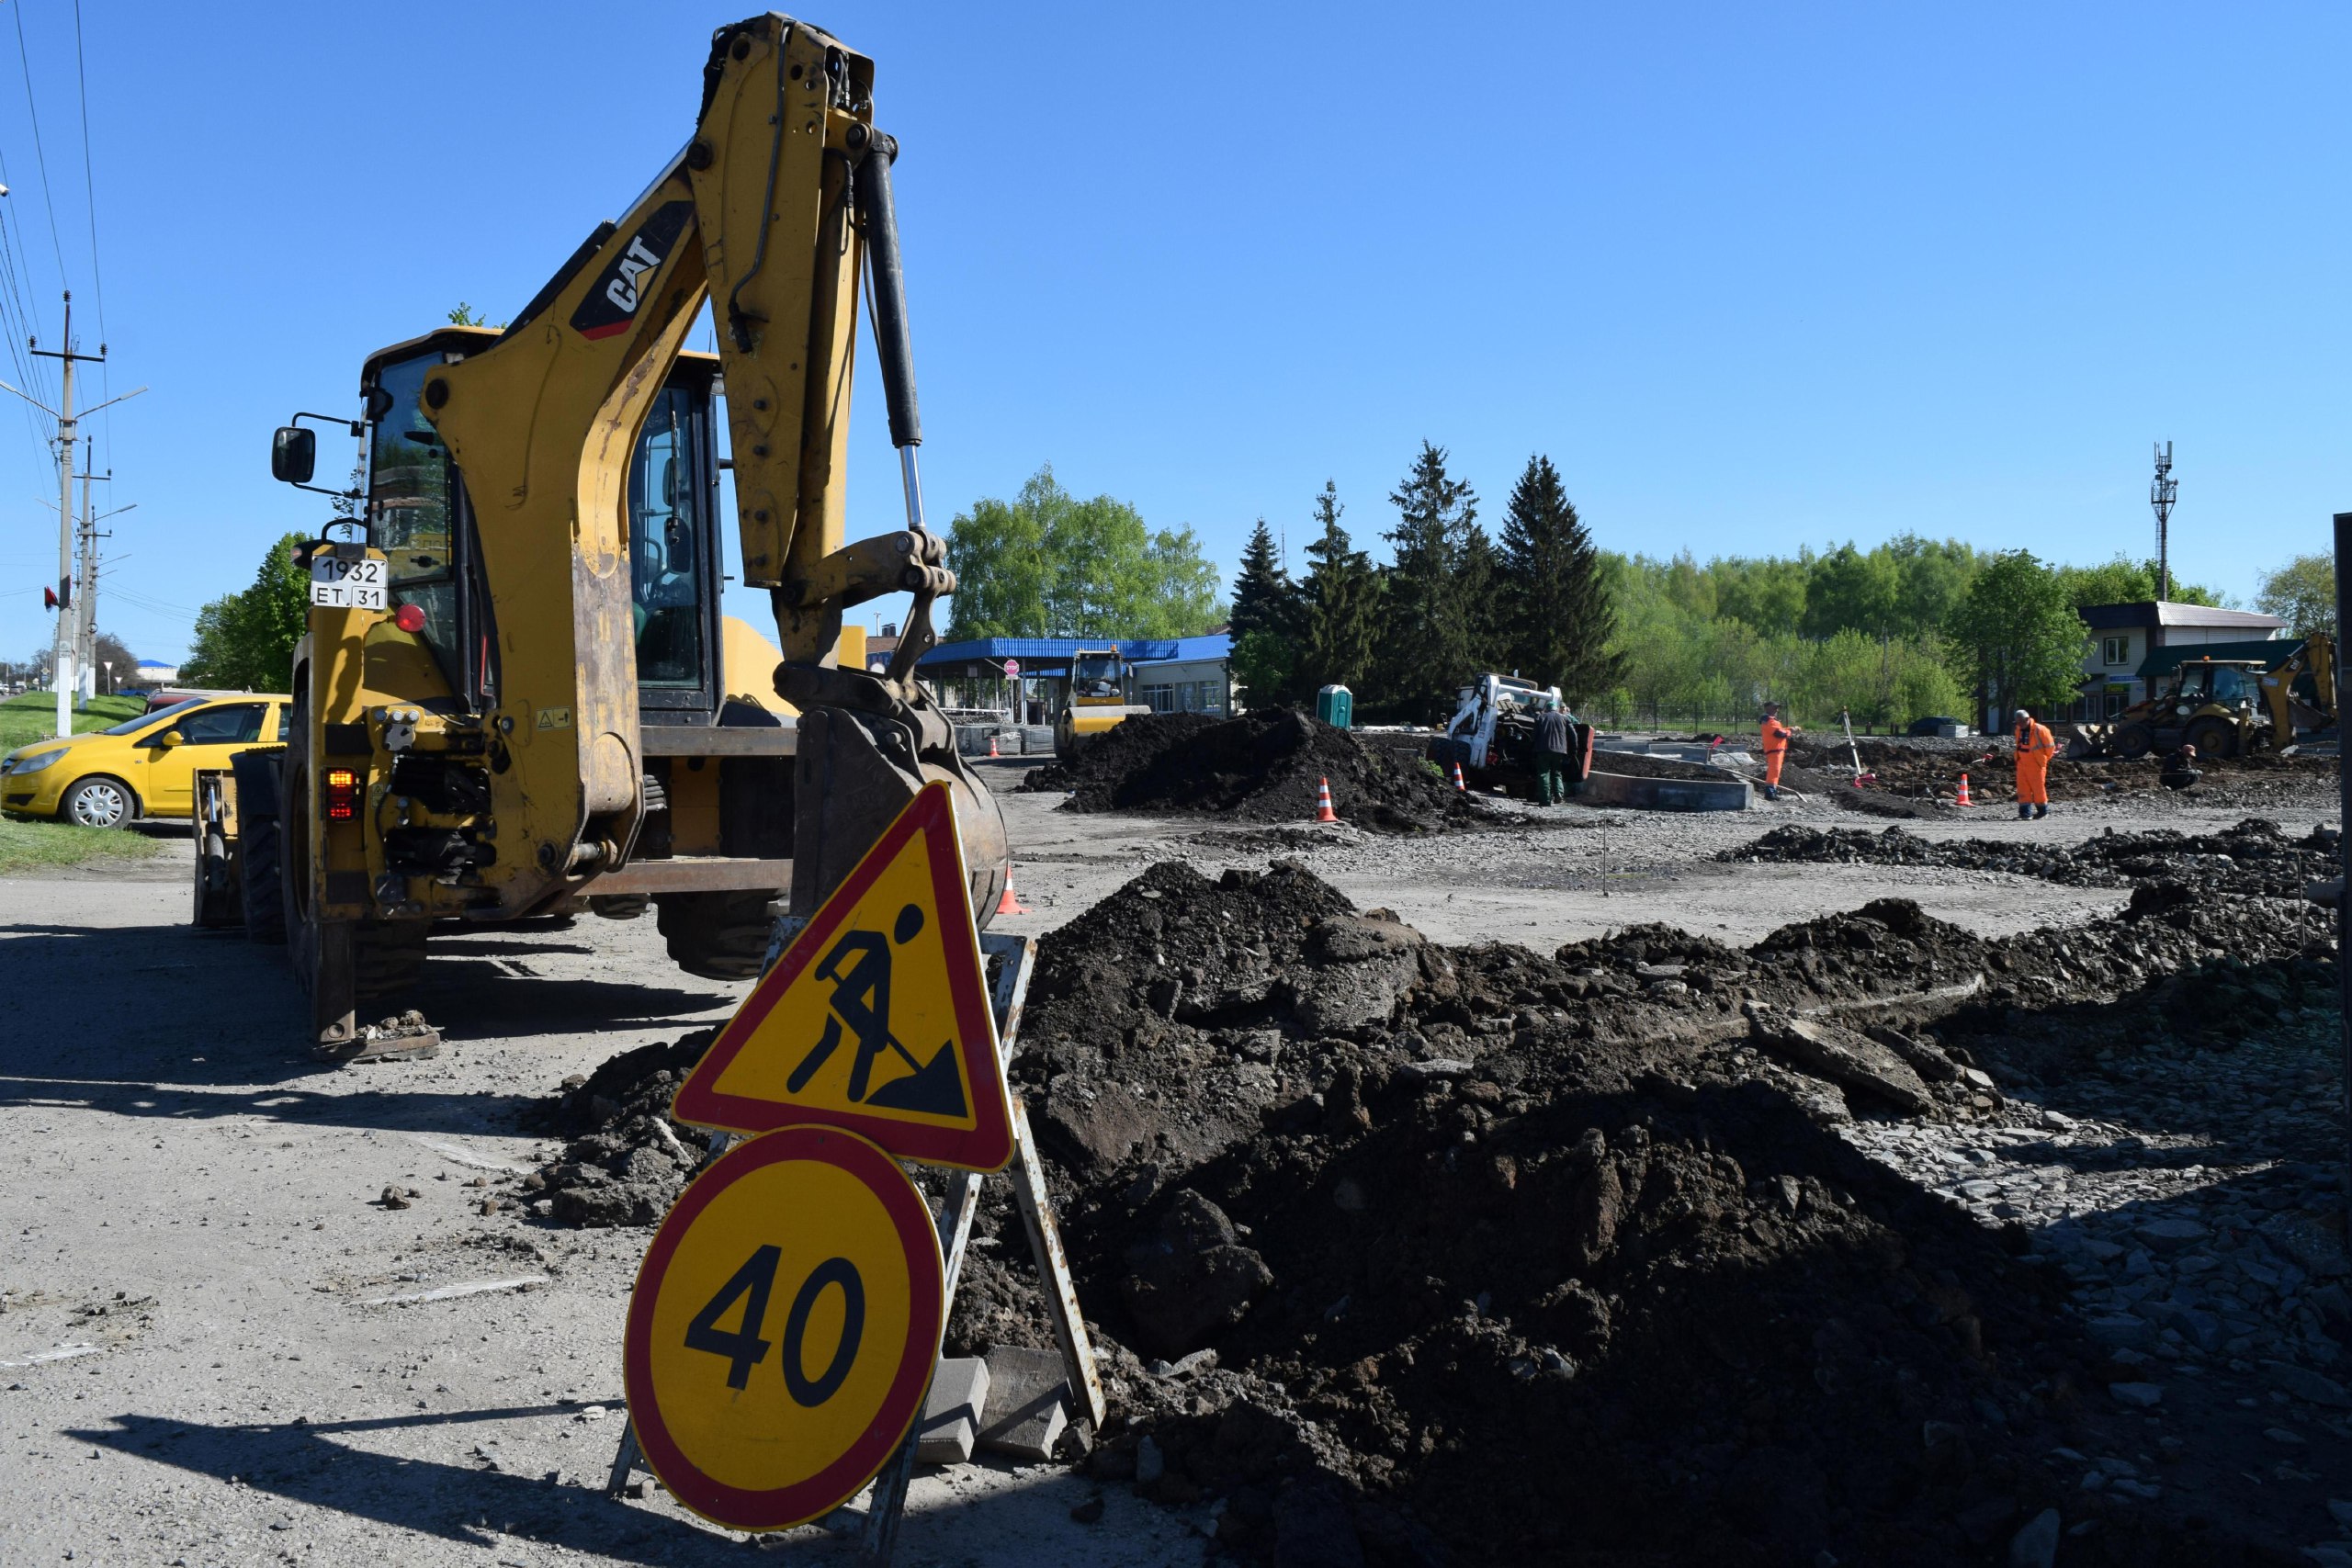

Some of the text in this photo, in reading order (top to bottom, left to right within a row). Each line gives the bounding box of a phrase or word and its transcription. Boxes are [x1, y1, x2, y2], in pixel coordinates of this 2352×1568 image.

[606, 235, 662, 312] CAT
[322, 559, 378, 583] 1932
[357, 590, 379, 606] 31
[684, 1244, 865, 1408] 40
